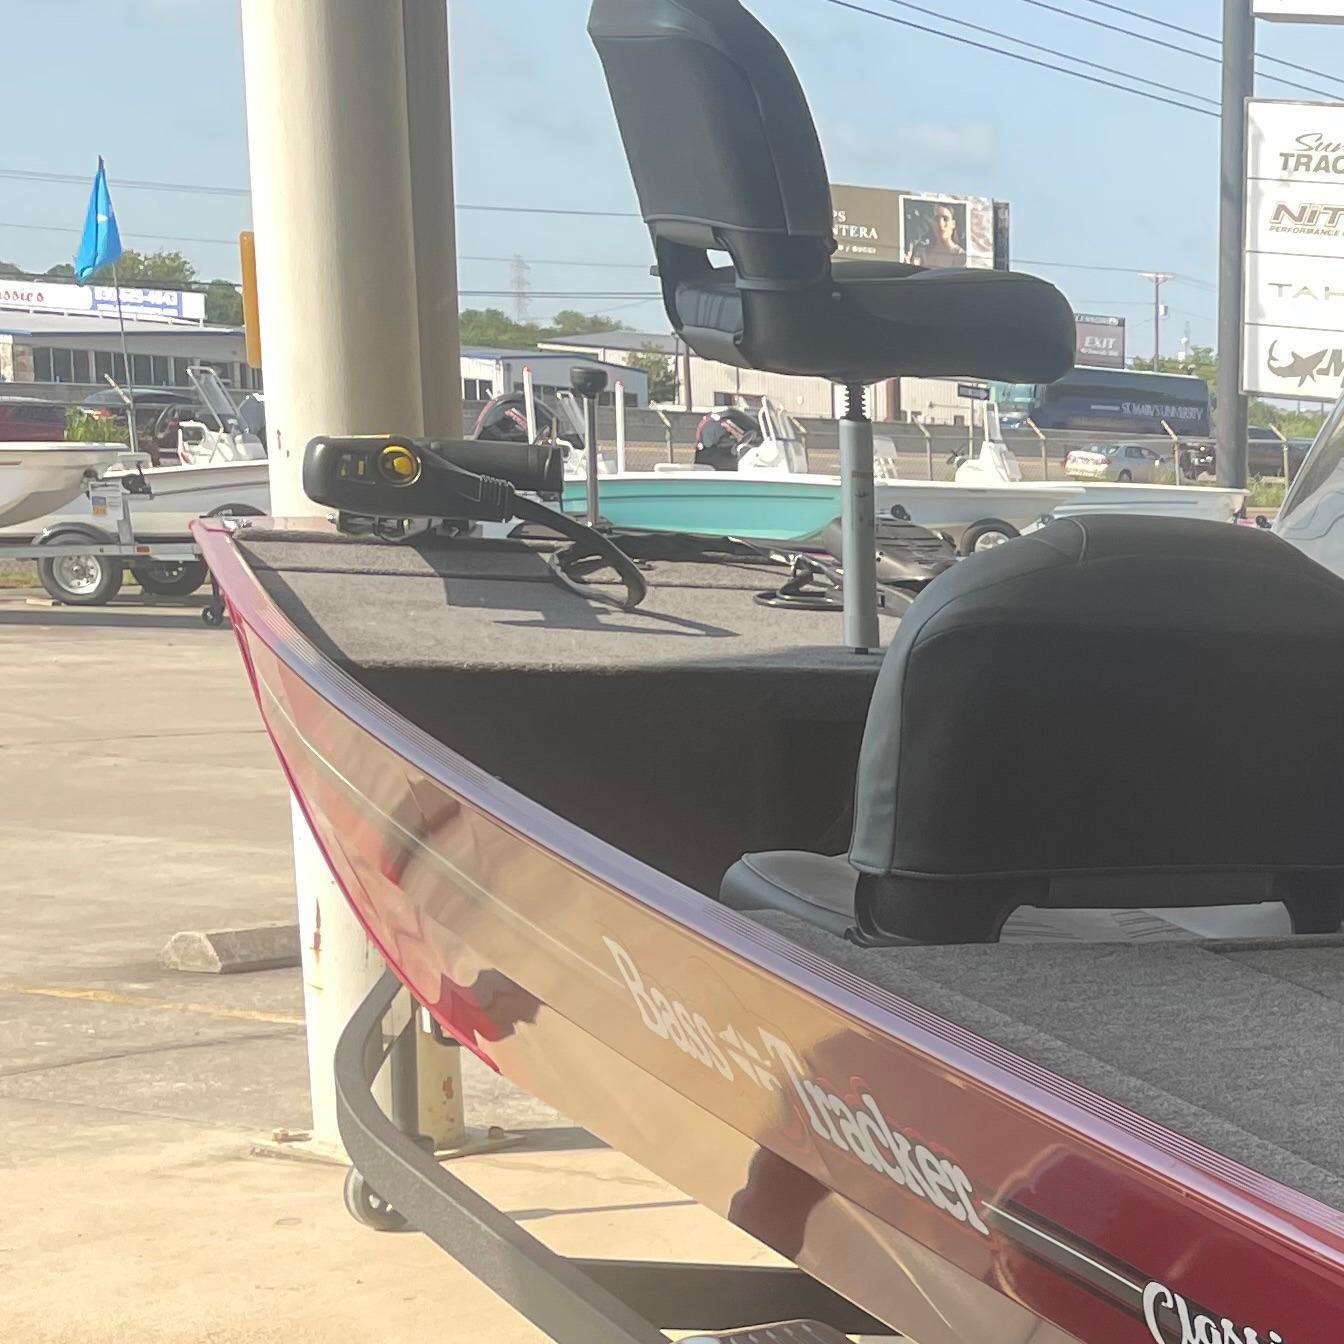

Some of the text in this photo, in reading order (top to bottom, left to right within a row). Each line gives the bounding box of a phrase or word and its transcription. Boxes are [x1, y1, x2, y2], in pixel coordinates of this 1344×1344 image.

[1269, 225, 1340, 237] PERFORMANCE
[1084, 335, 1116, 350] EXIT
[603, 935, 991, 1236] Bass Tracker
